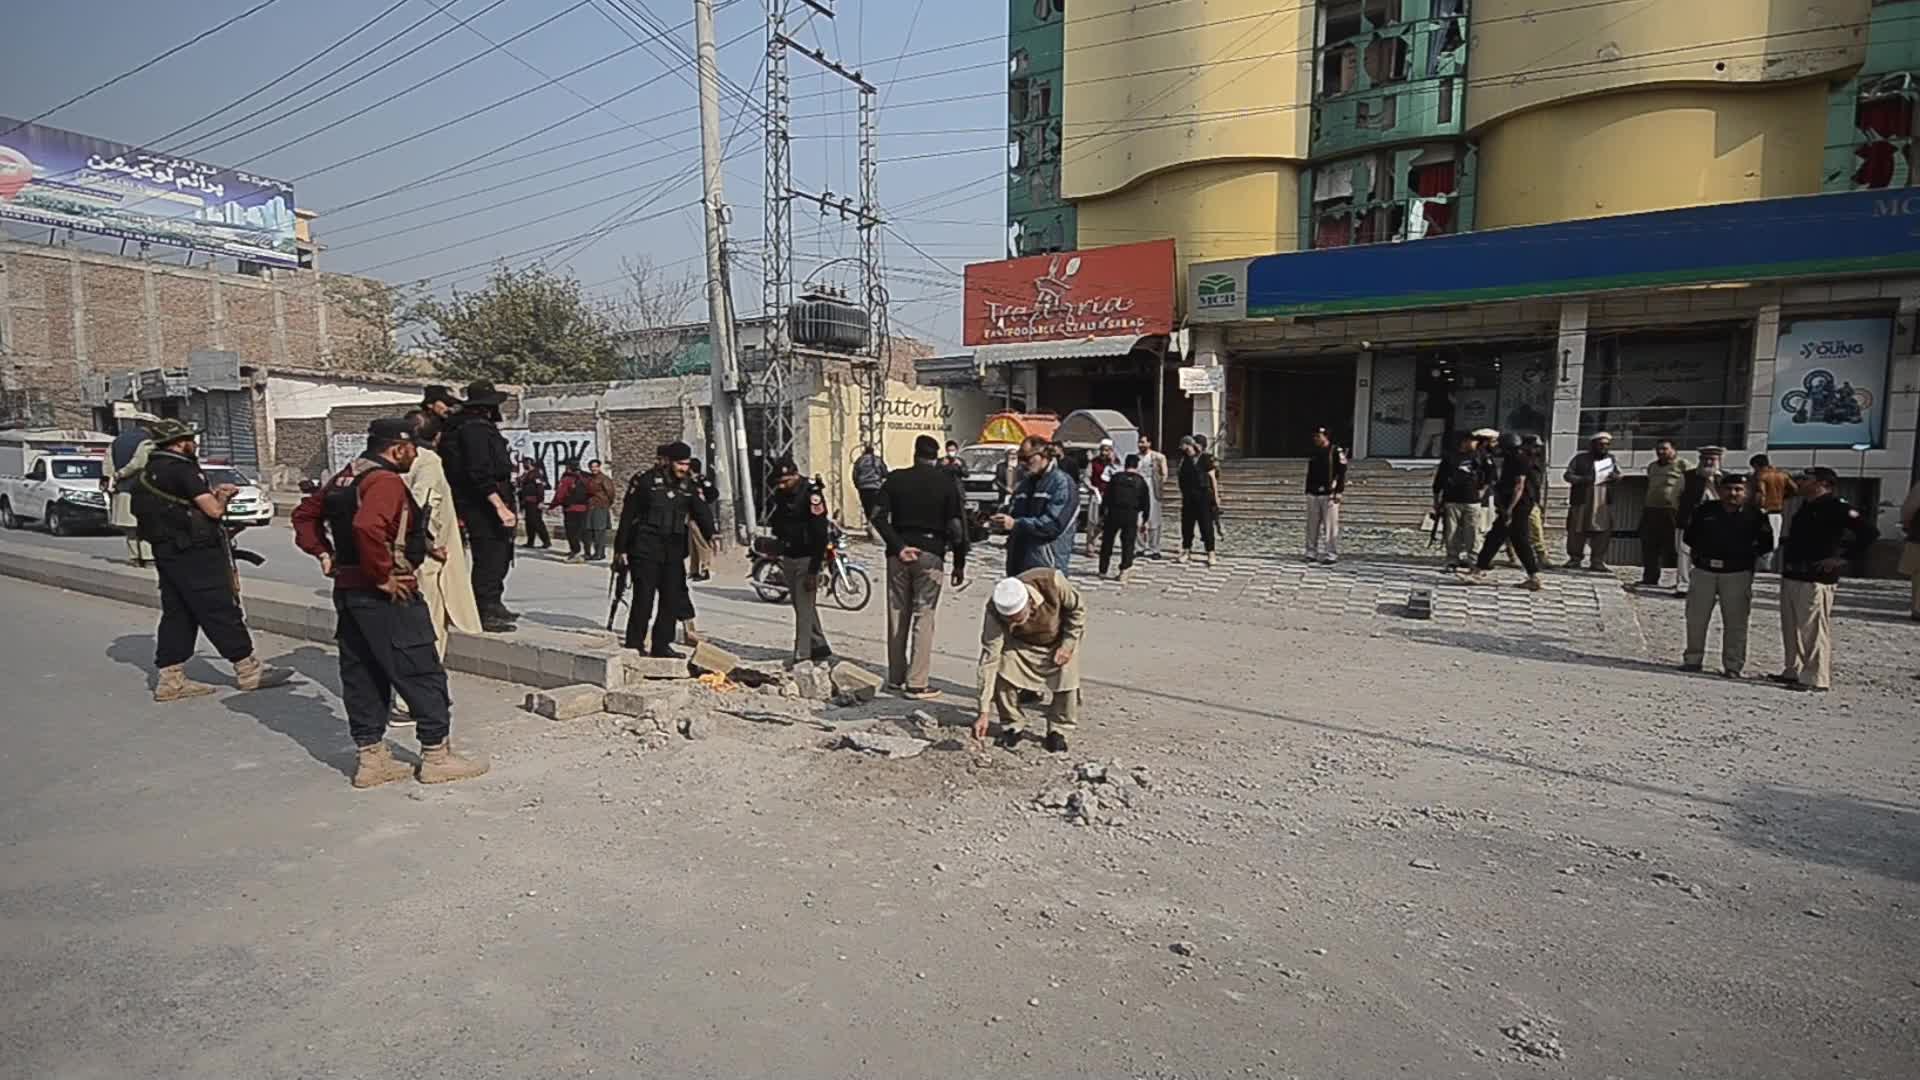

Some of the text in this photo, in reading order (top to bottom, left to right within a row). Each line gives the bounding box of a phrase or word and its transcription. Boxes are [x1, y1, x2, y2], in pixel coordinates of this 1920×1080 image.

[1200, 294, 1235, 305] MCB
[1800, 342, 1864, 359] YOUNG
[533, 440, 590, 490] KPK
